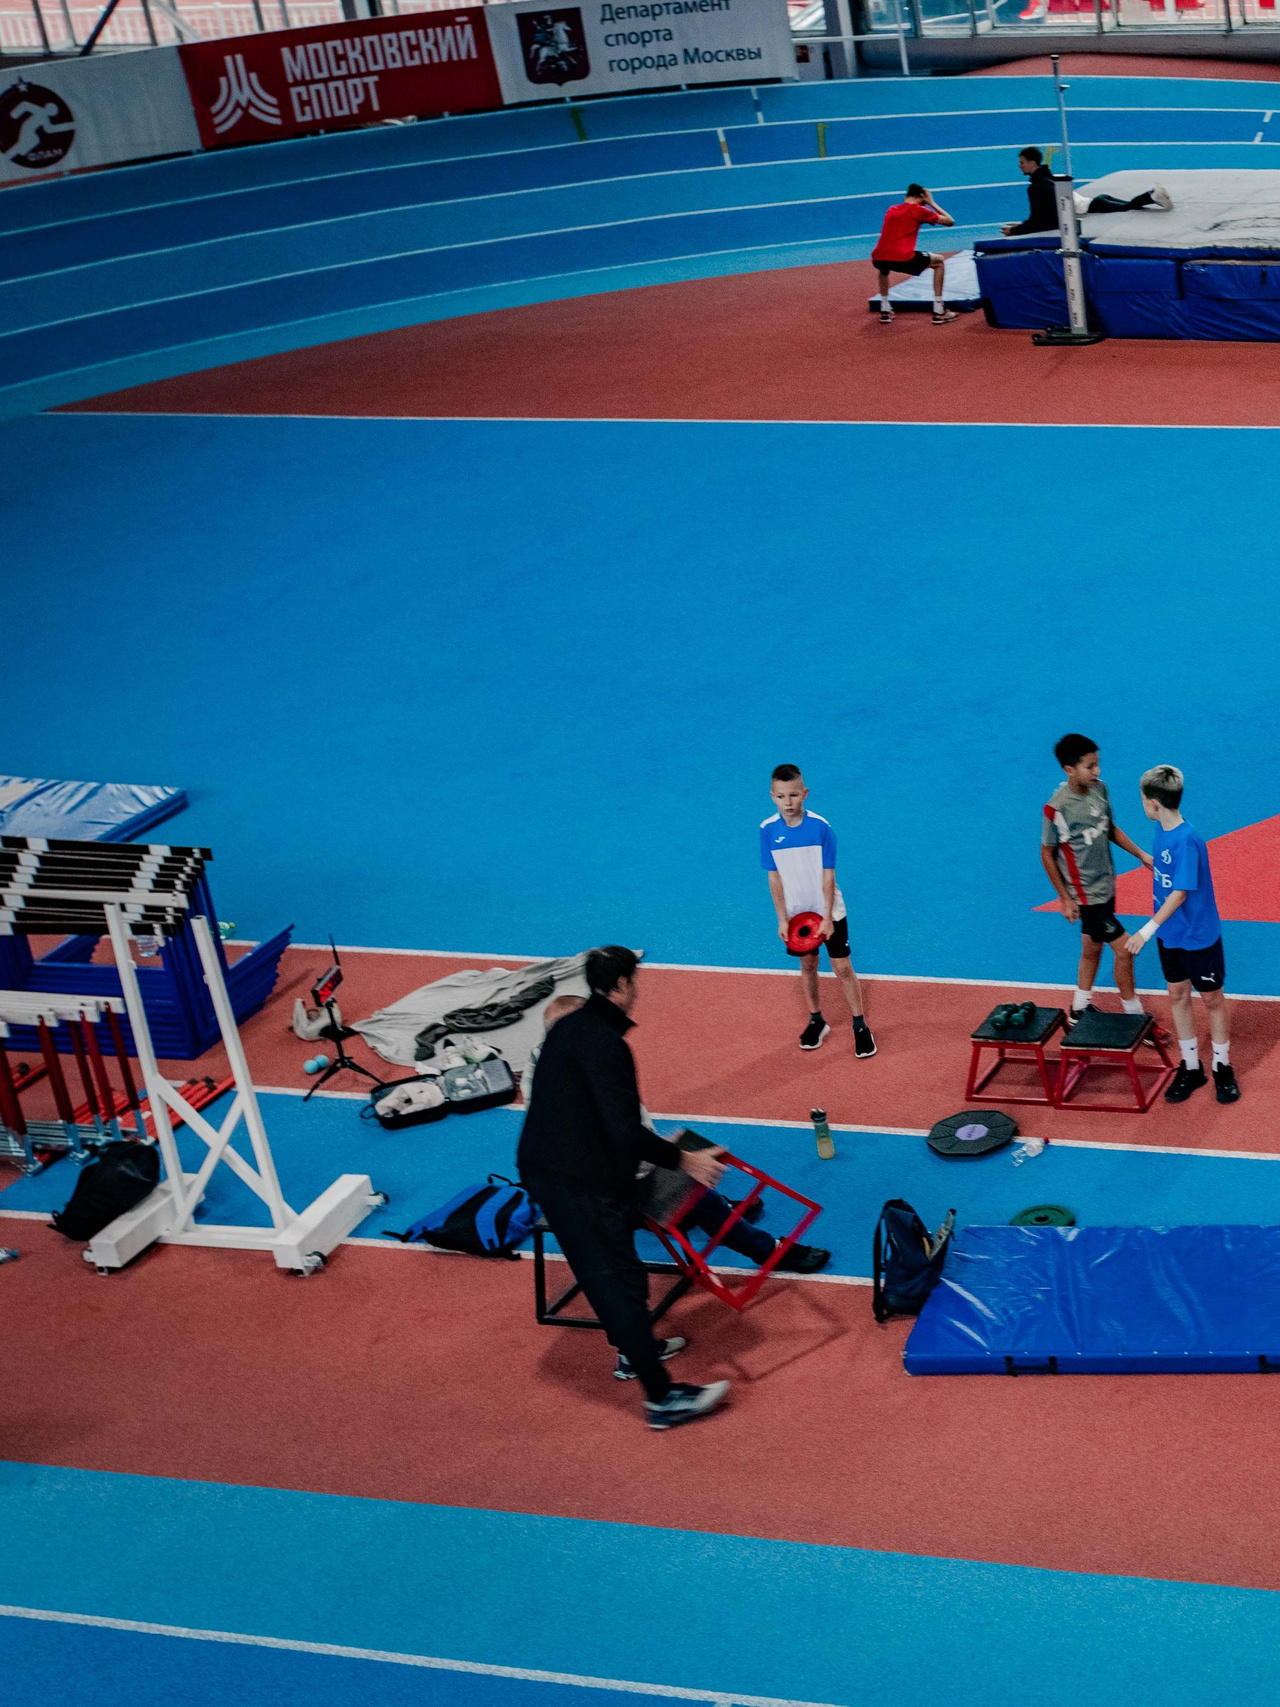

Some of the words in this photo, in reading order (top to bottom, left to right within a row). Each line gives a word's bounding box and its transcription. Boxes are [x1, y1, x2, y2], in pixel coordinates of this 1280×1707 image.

[600, 0, 731, 25] Департамент
[280, 16, 479, 84] МОСКОВСКИЙ
[604, 28, 674, 49] спорта
[608, 53, 679, 76] города
[683, 47, 763, 66] Москвы
[290, 75, 381, 123] СПОРТ
